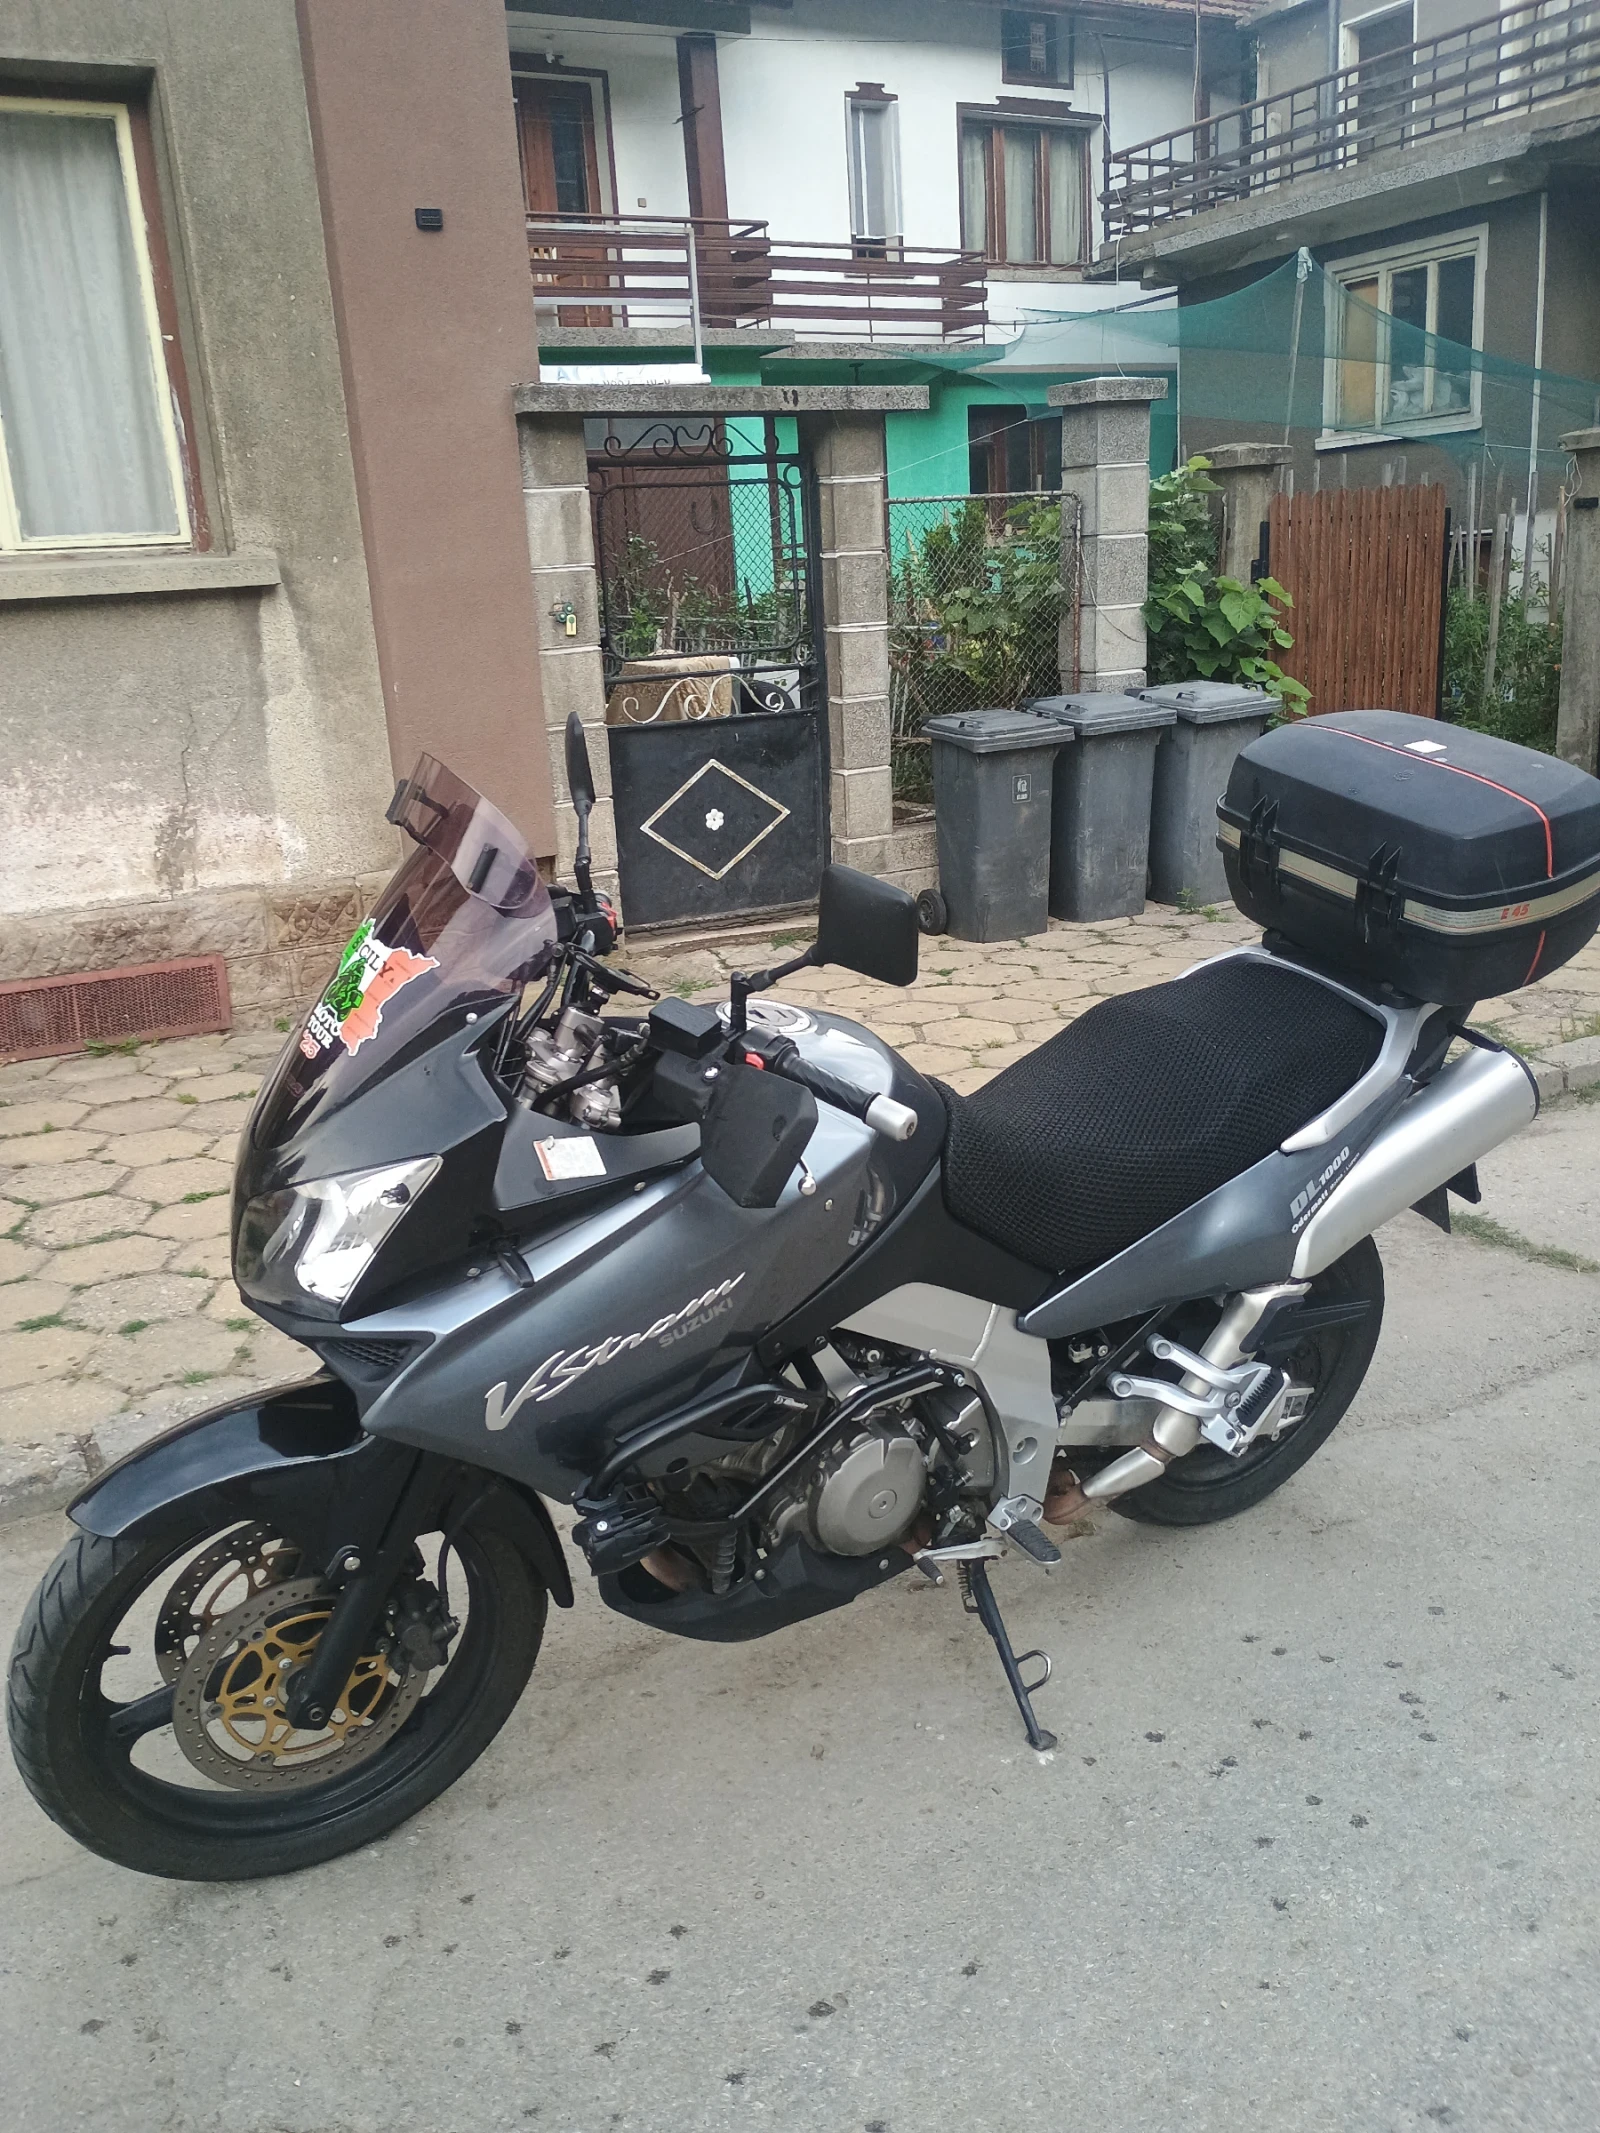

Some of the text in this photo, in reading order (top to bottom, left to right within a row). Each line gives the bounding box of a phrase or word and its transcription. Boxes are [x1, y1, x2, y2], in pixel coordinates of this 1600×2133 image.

[1512, 904, 1531, 917] 45
[307, 1014, 334, 1049] TOUR
[1290, 1146, 1350, 1219] DL1000
[658, 1297, 733, 1348] SUZUKI
[484, 1271, 746, 1431] V-Strom
